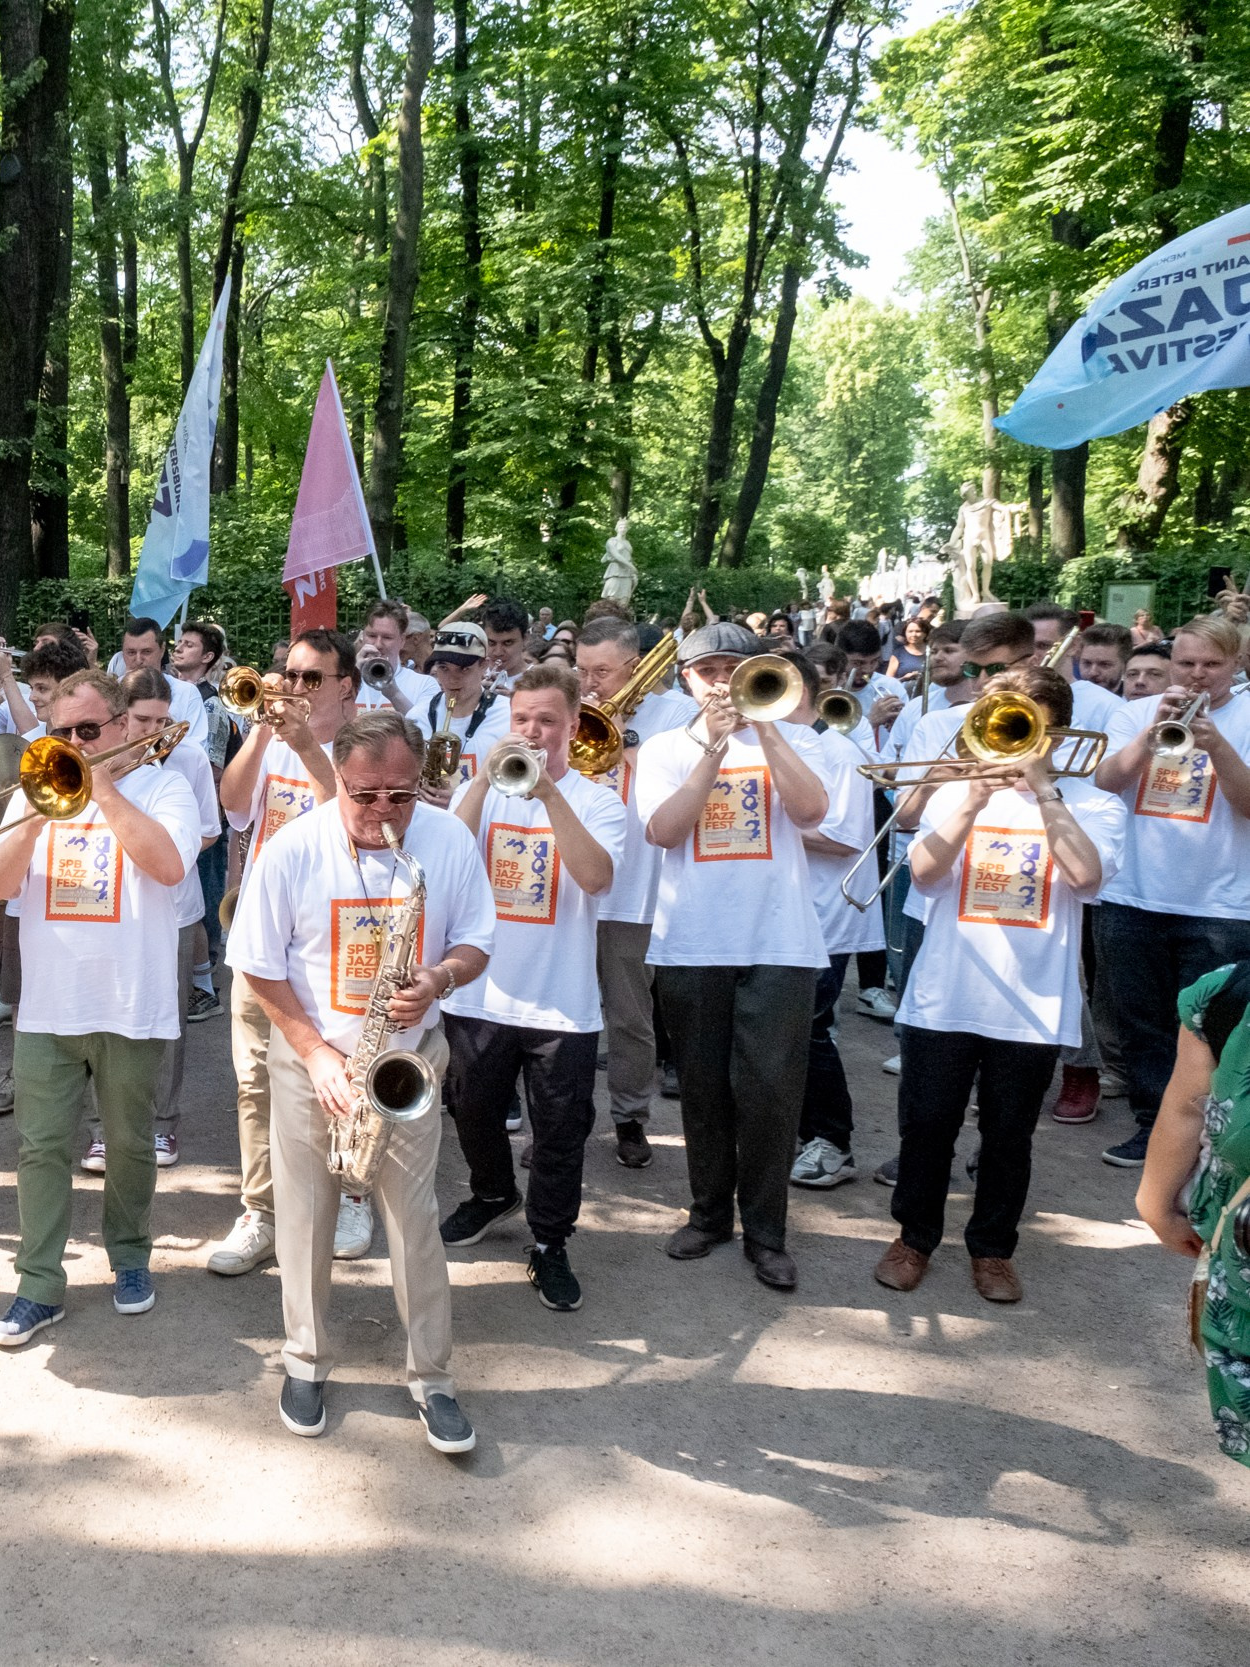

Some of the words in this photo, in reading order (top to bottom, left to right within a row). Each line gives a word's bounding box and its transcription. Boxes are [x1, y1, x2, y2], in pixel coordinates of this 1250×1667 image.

[1157, 768, 1179, 777] SPB
[1154, 776, 1182, 786] JAZZ
[1151, 783, 1180, 793] FEST
[705, 803, 729, 811] SPB
[706, 812, 736, 821] JAZZ
[705, 821, 735, 829] FEST
[59, 859, 82, 868] SPB
[496, 859, 519, 870] SPB
[977, 863, 1005, 872] SPB
[58, 869, 87, 878] JAZZ
[496, 869, 524, 880] JAZZ
[976, 872, 1012, 883] JAZZ
[56, 879, 84, 888] FEST
[495, 878, 521, 889] FEST
[975, 882, 1008, 892] FEST
[347, 944, 375, 955] SPB
[346, 968, 379, 978] FEST
